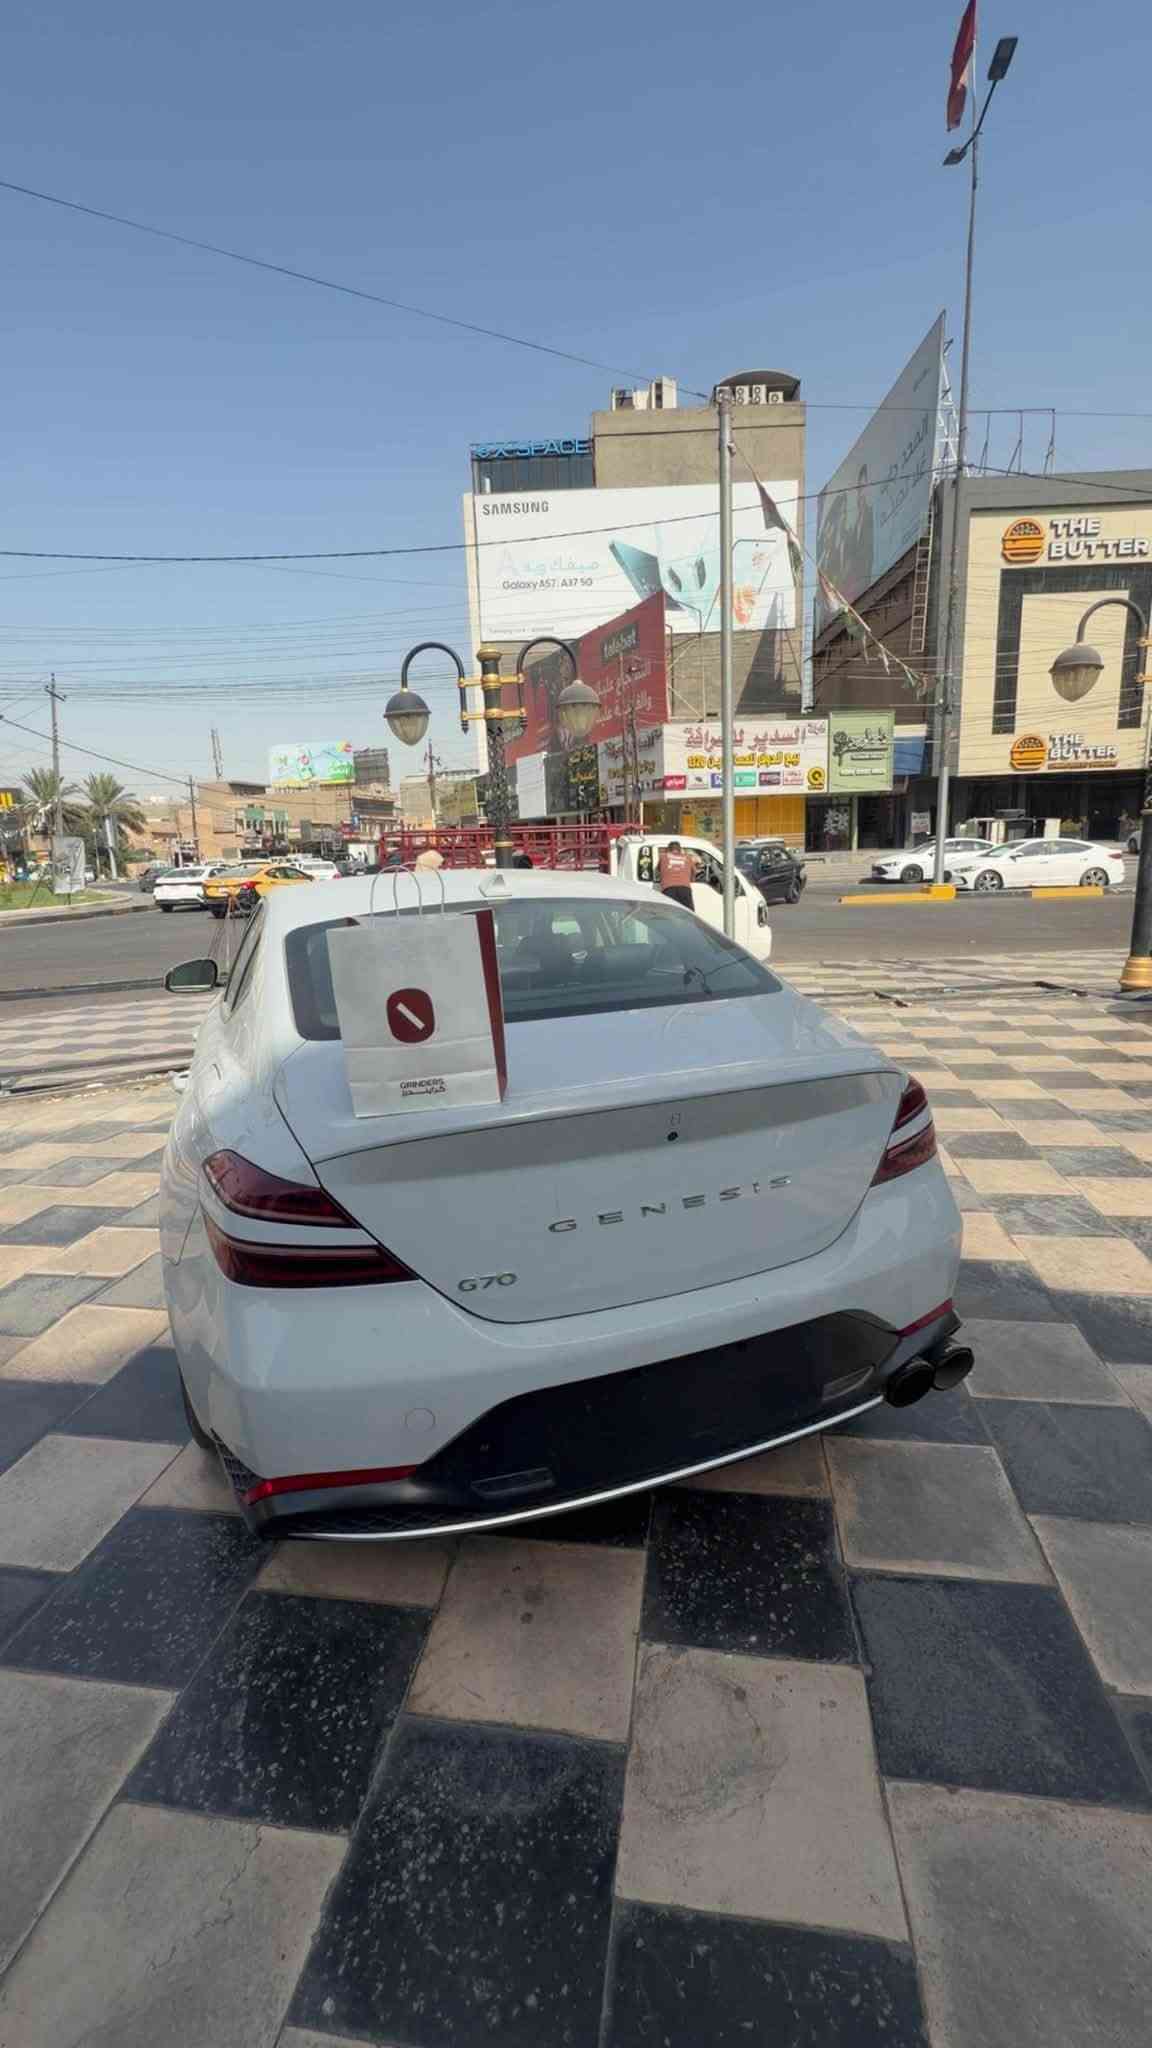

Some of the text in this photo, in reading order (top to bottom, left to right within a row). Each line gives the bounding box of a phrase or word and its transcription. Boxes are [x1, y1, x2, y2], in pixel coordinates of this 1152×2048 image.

[482, 501, 549, 516] SAMSUNG
[1048, 518, 1103, 538] THE
[1047, 538, 1149, 562] BUTTER
[502, 579, 537, 591] Galaxy
[1049, 734, 1084, 746] THE
[1048, 745, 1118, 761] BUTTER
[548, 1175, 792, 1233] GENESIS
[458, 1272, 517, 1293] G70
